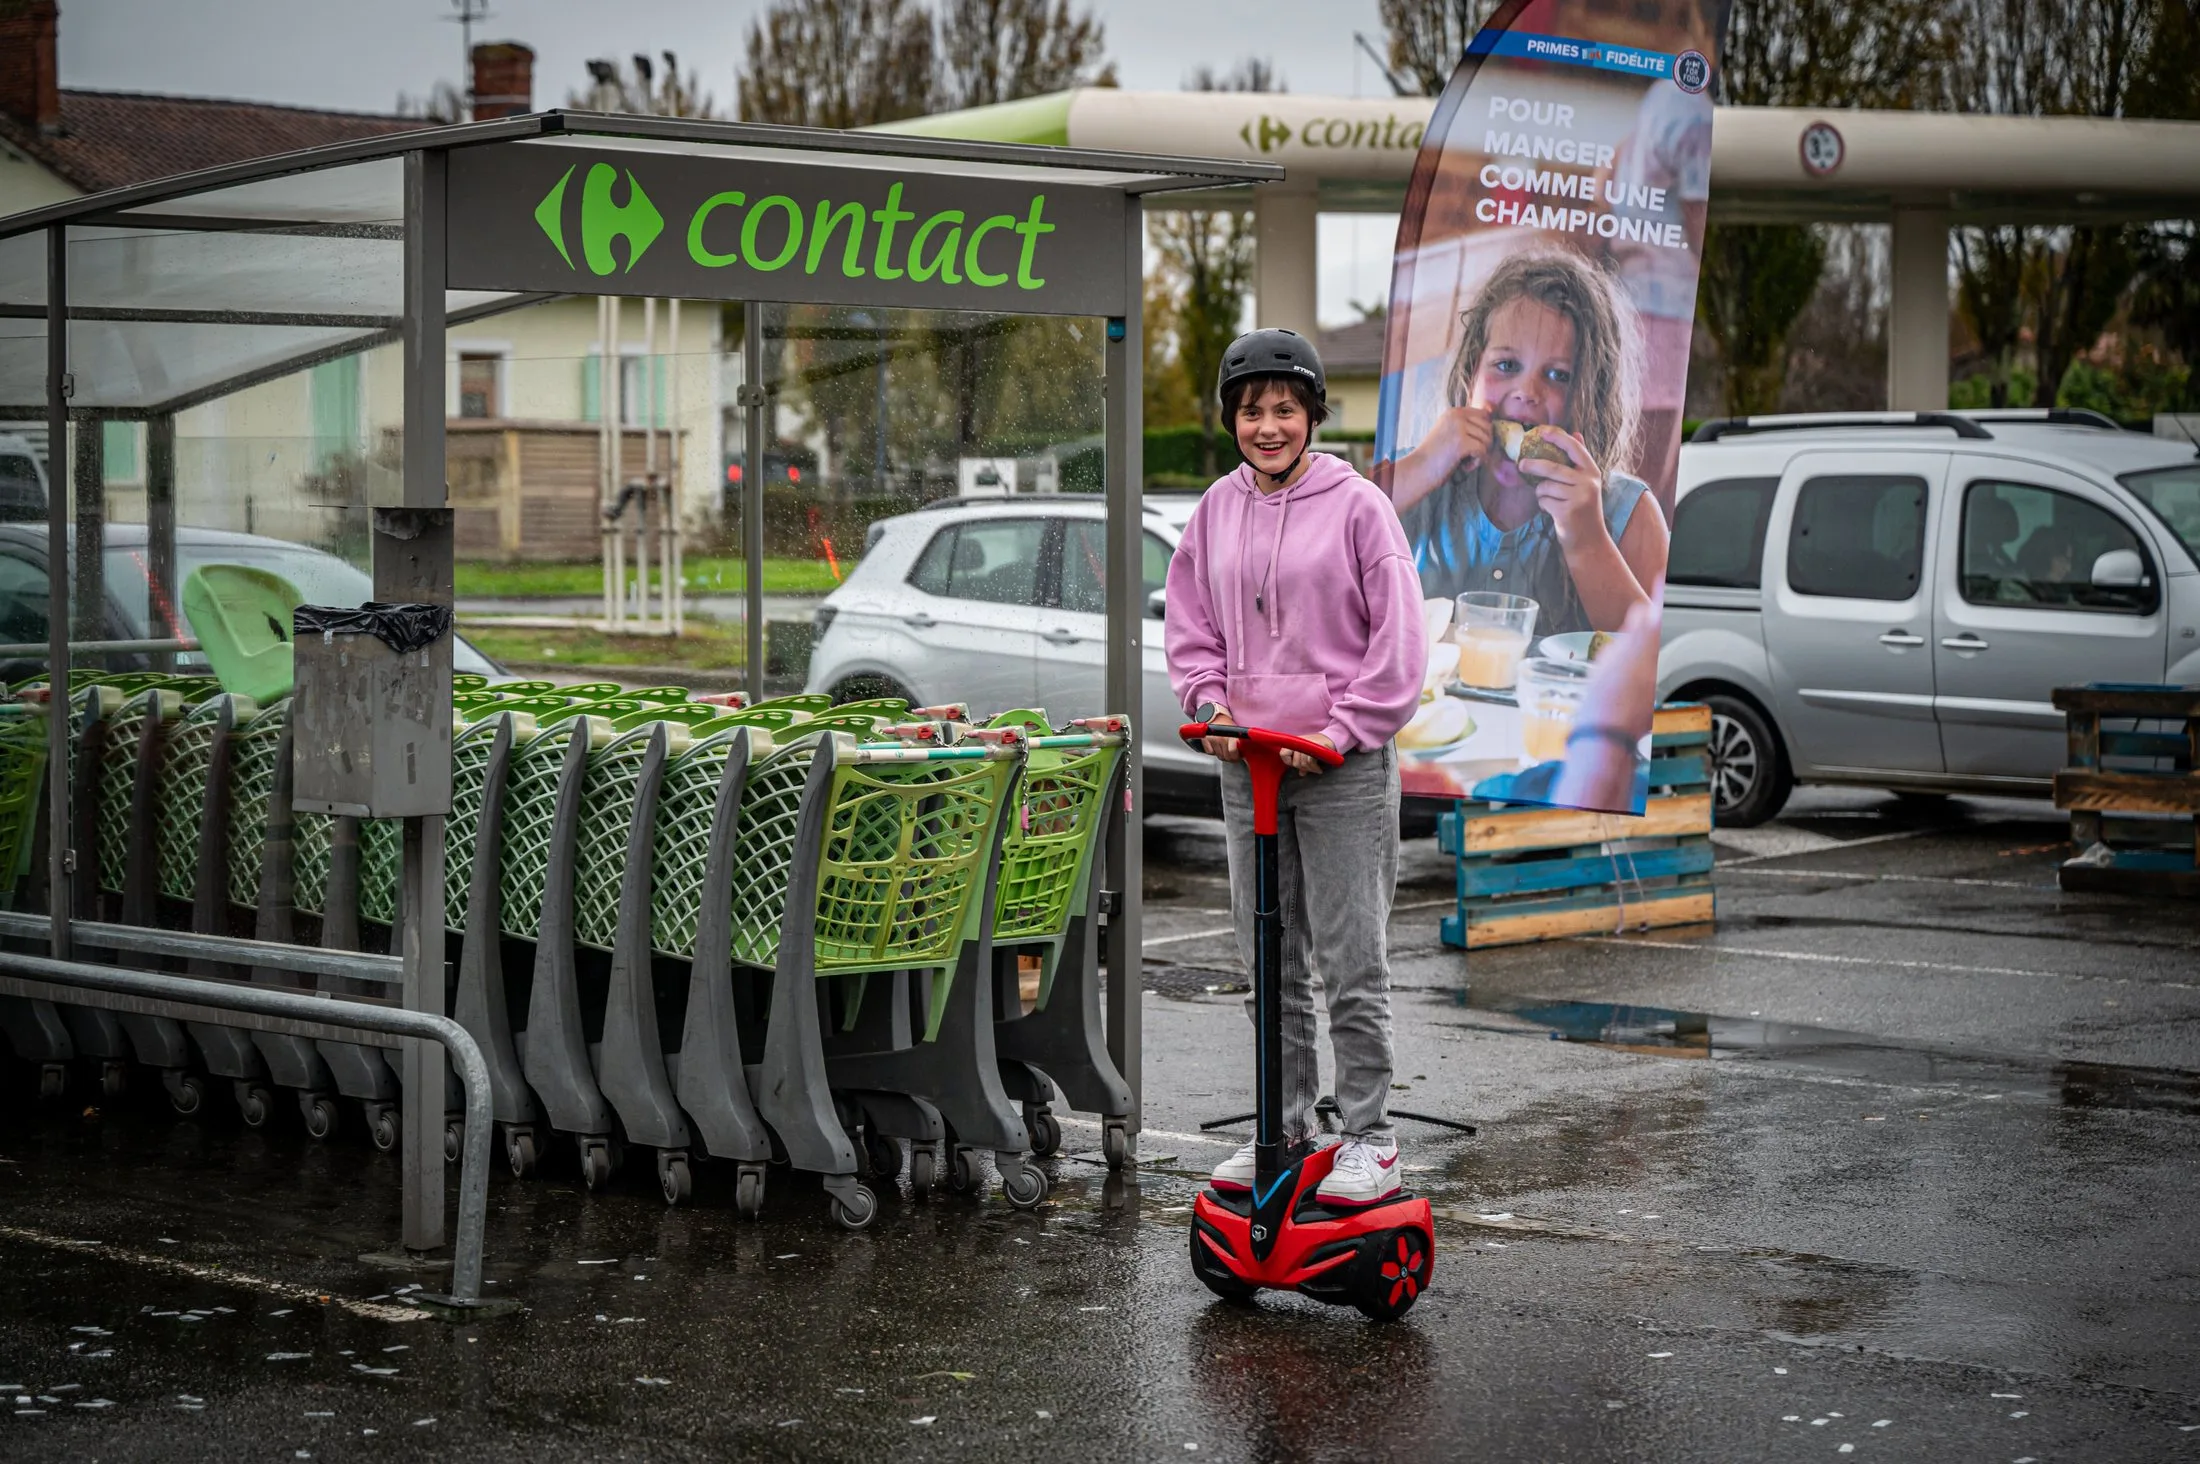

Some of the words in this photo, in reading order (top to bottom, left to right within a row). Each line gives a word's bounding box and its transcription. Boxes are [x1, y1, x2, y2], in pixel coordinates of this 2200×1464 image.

[1527, 40, 1579, 57] PRIMES
[1606, 51, 1665, 72] FIDÉLITÉ
[1683, 73, 1699, 84] FOOD
[1488, 97, 1574, 129] POUR
[1301, 114, 1423, 149] conta
[1484, 131, 1615, 169] MANGER
[1480, 164, 1596, 201] COMME
[1604, 180, 1666, 212] UNE
[687, 182, 1056, 290] contact
[1475, 198, 1689, 249] CHAMPIONNE.
